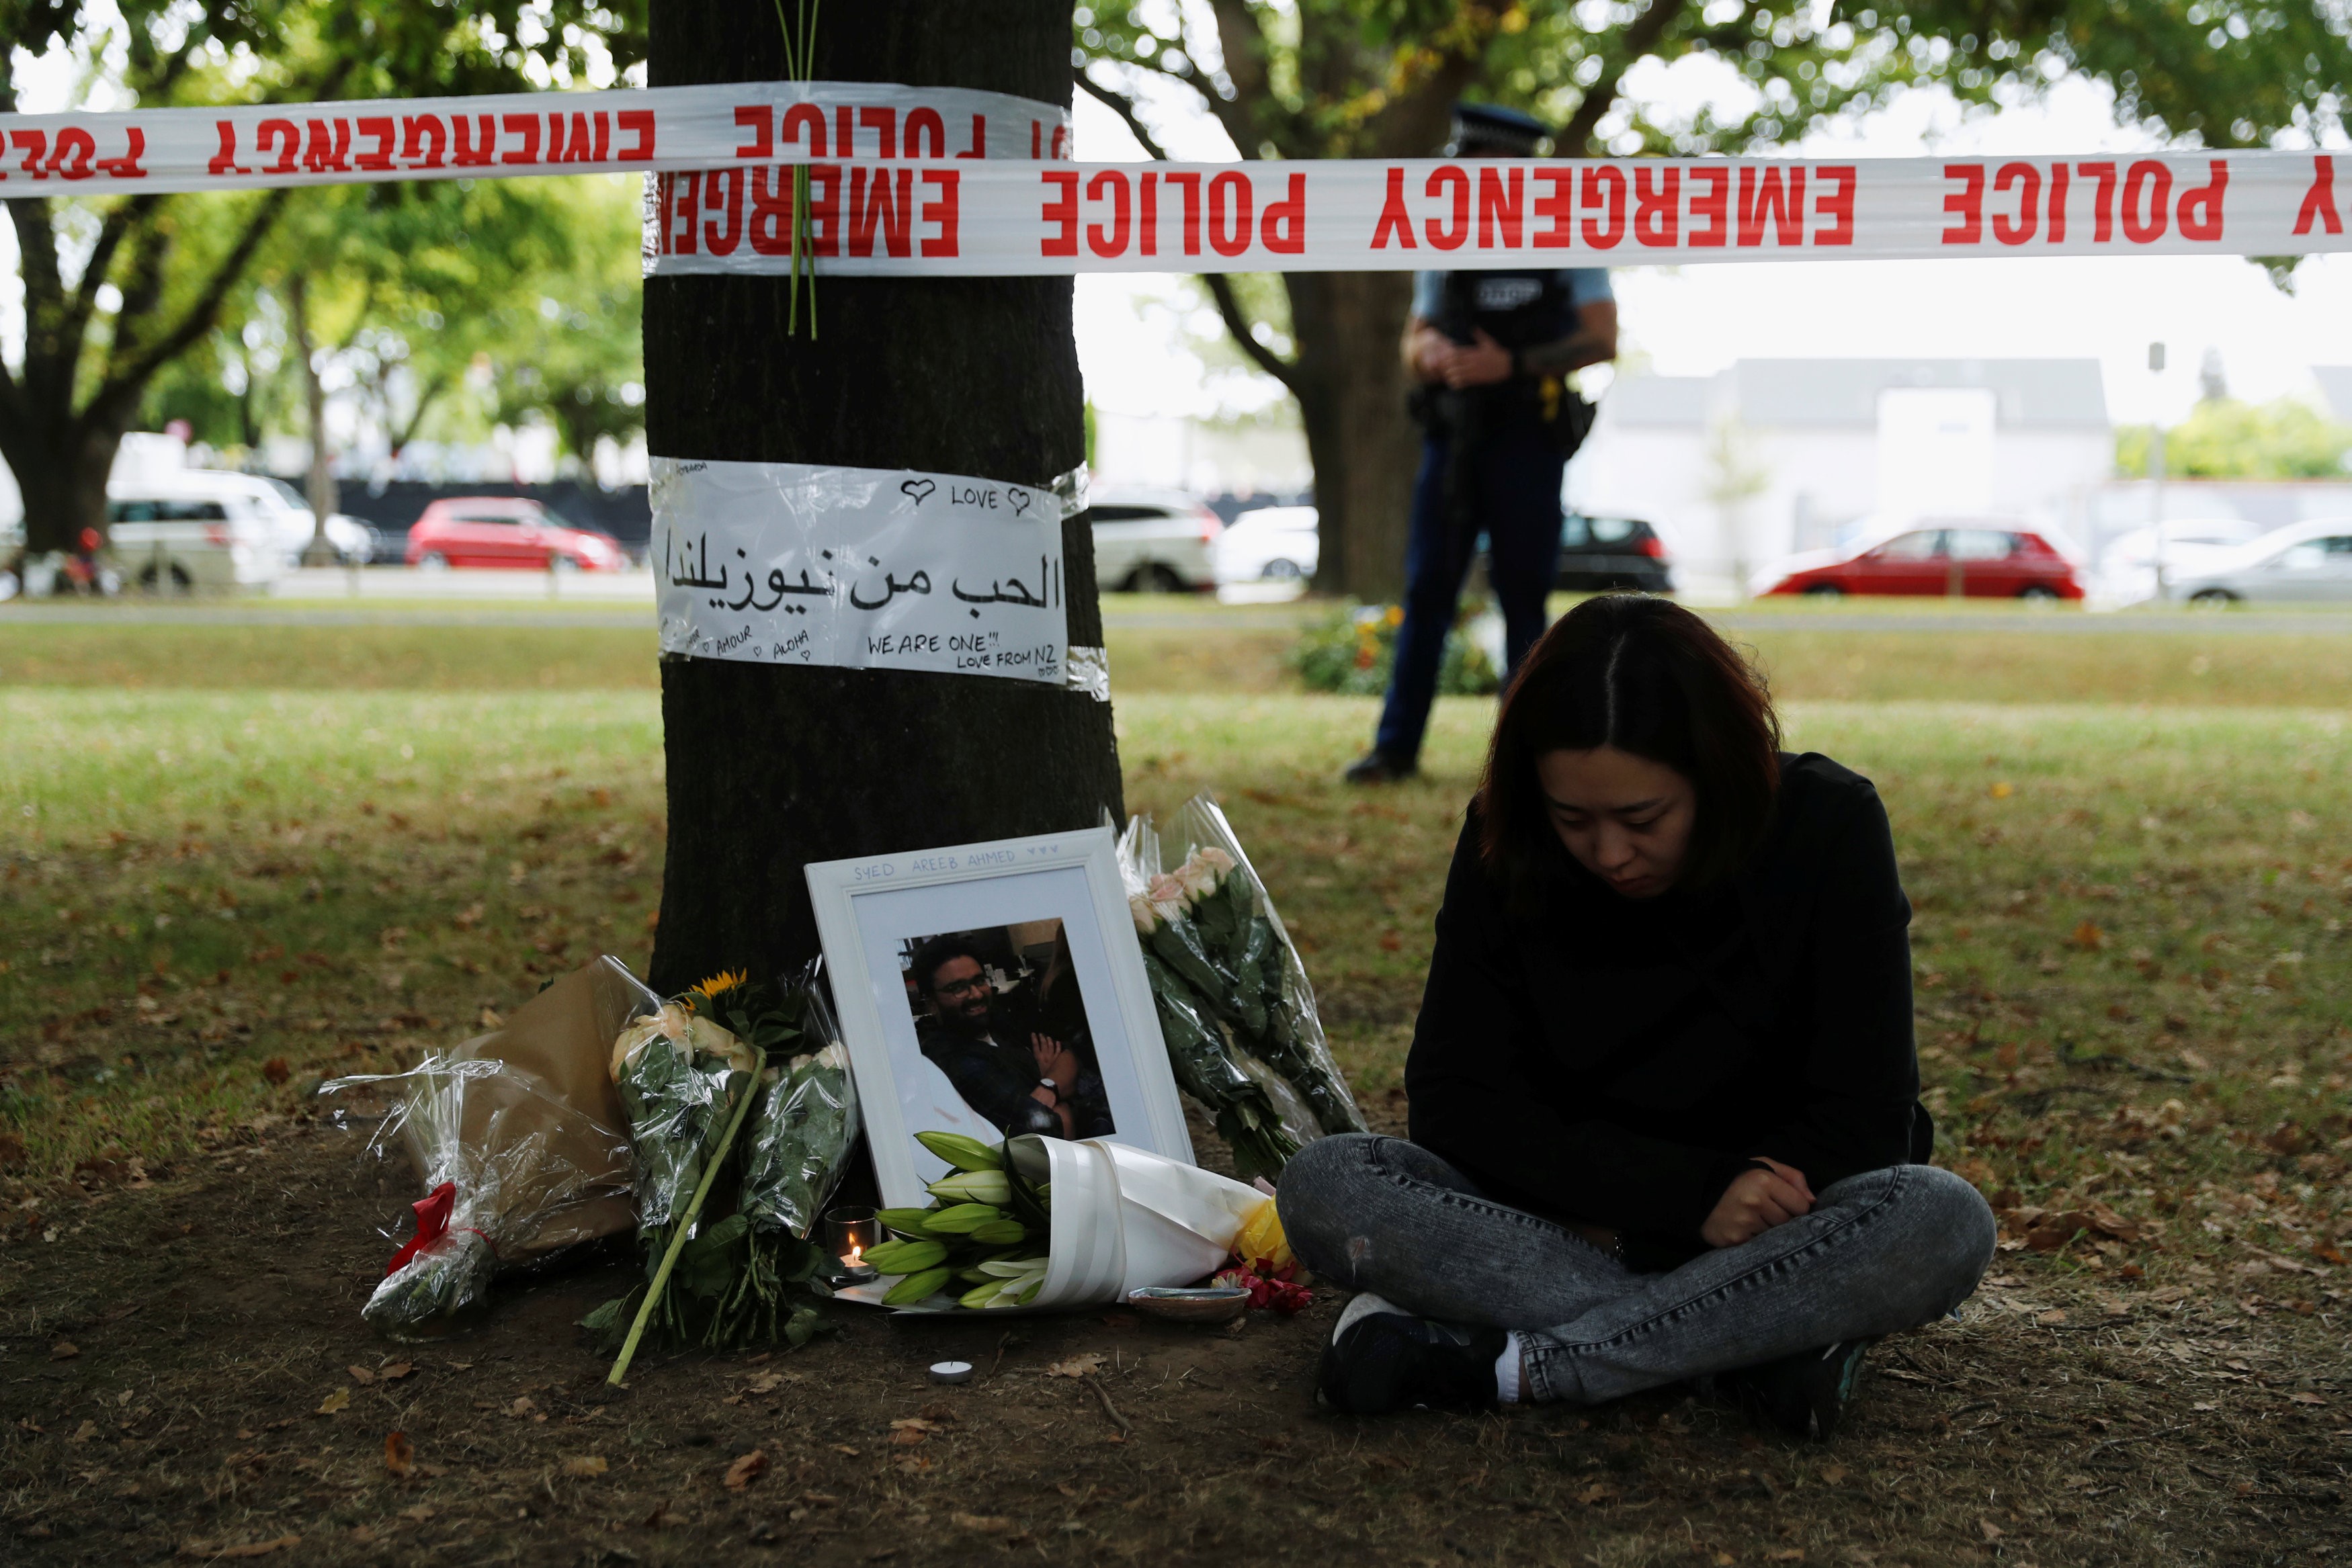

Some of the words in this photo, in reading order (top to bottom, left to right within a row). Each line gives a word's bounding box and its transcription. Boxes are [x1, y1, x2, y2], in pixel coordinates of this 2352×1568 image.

[1041, 170, 1306, 258] POLICE
[1370, 165, 1856, 251] EMERGENCY
[1942, 160, 2229, 246] POLICE
[952, 486, 998, 509] LOVE
[666, 527, 835, 615] نيوزيلندا
[850, 556, 931, 611] من
[952, 554, 1058, 619] الحب
[717, 625, 753, 656] AMOUR
[773, 629, 809, 659] ALOHA
[868, 635, 894, 654] WE
[898, 634, 941, 654] ARE
[958, 655, 991, 668] LOVE
[997, 650, 1031, 666] FROM
[1035, 644, 1056, 666] NZ
[855, 863, 894, 881] SYED
[913, 857, 958, 873] AREEB
[968, 850, 1015, 866] AHMED
